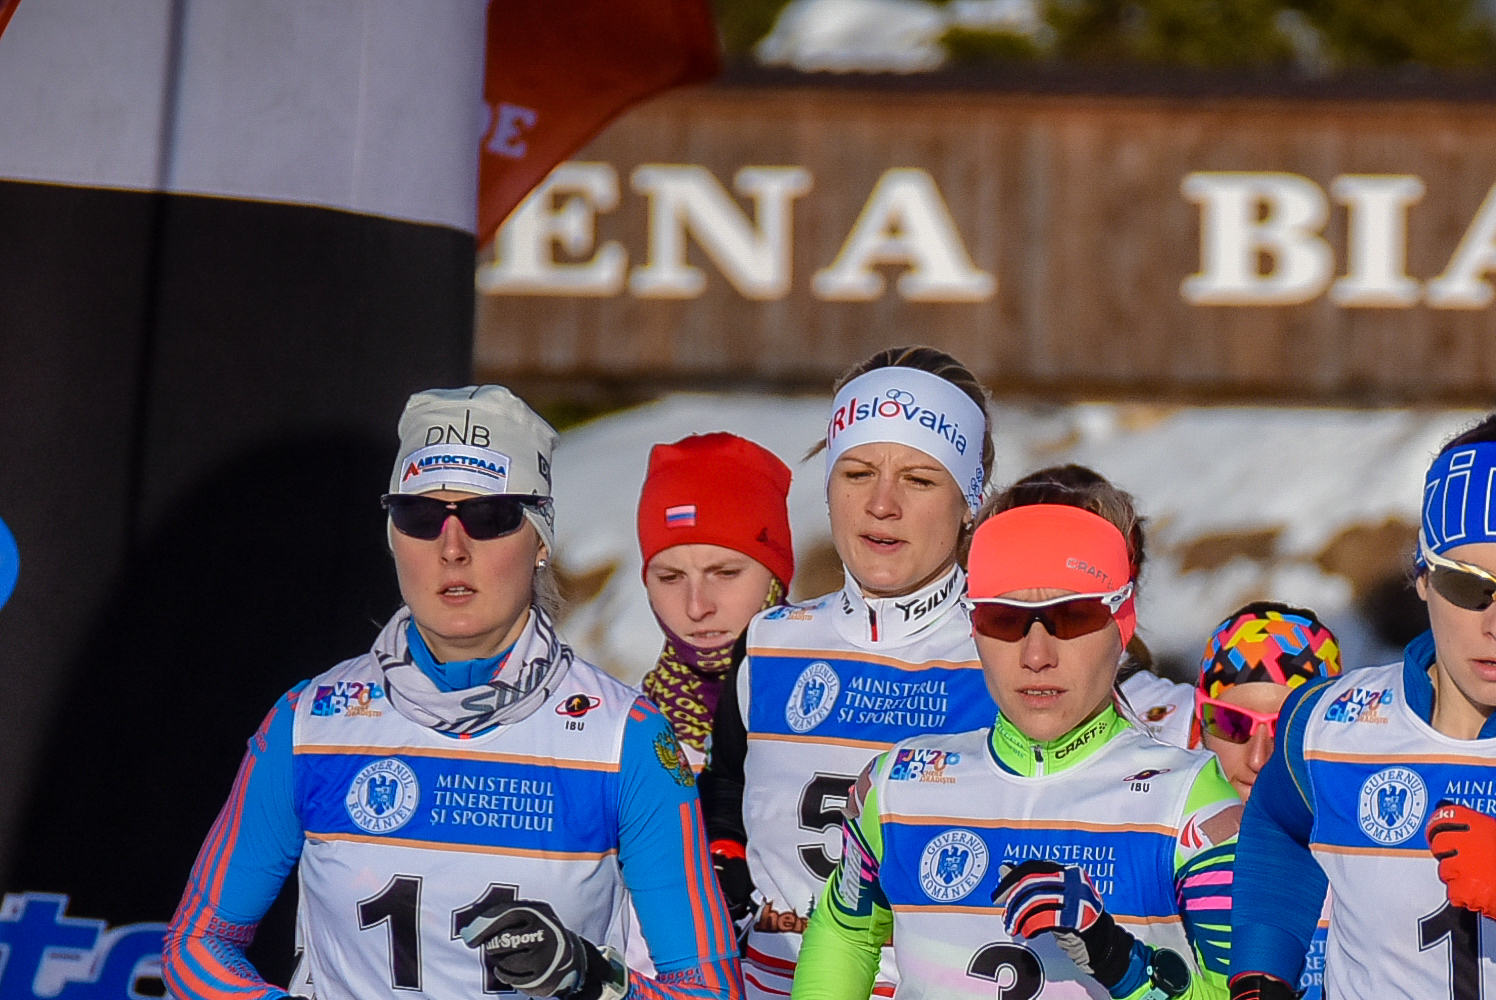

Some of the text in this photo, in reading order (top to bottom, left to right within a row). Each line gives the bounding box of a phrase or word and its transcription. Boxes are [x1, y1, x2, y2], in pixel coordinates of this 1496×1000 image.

[475, 161, 998, 303] ENA
[424, 409, 491, 448] DNB
[1066, 557, 1108, 583] CRAFT
[848, 676, 949, 696] MINISTERUL
[845, 690, 948, 712] TINERETULUI
[565, 721, 585, 731] IBU
[855, 711, 947, 728] SPORTULUI
[1055, 727, 1098, 759] CRAFT
[436, 774, 555, 797] MINISTERUL
[1130, 782, 1150, 793] IBU
[1363, 770, 1424, 797] GUVERNUL
[433, 790, 554, 814] TINERETULUI
[451, 809, 554, 832] SPORTULUI
[797, 771, 858, 883] 5
[926, 832, 982, 860] GUVERNUL
[1003, 842, 1117, 862] MINISTERUL
